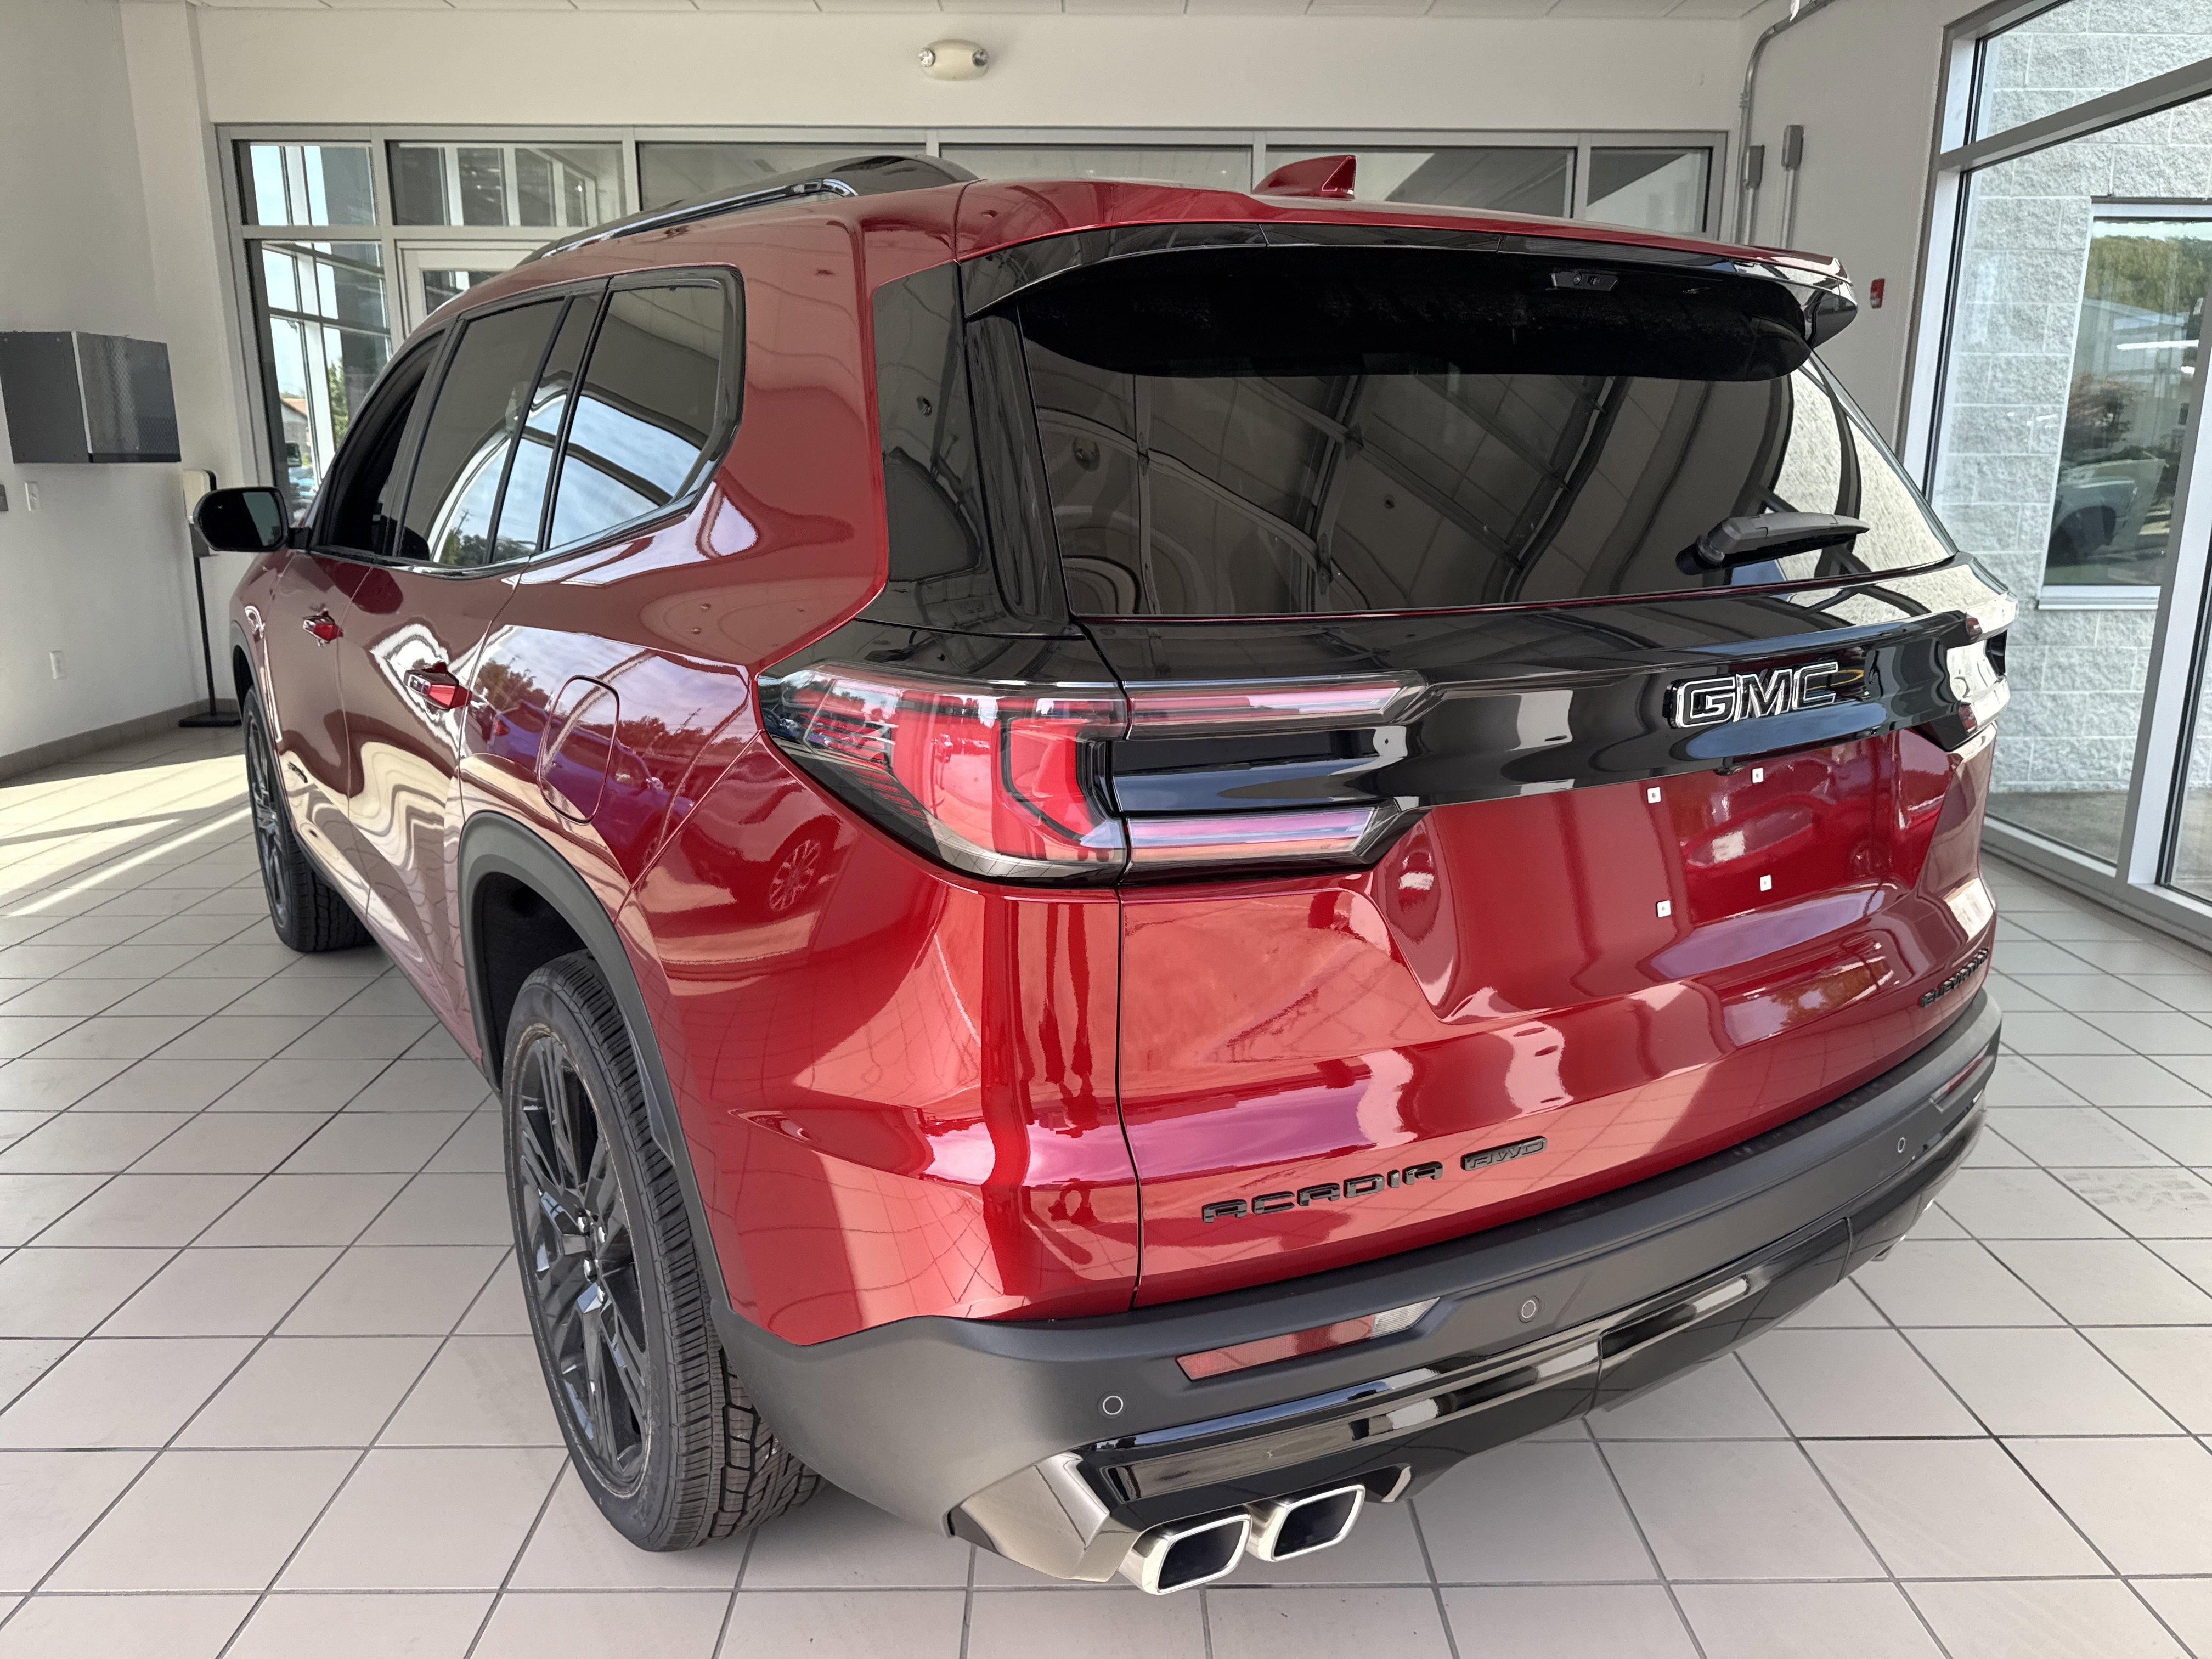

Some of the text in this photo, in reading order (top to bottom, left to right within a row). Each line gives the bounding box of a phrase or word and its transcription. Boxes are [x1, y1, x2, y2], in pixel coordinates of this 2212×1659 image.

[1672, 661, 1838, 729] GMC
[1201, 1139, 1545, 1223] ACADIA AWD
